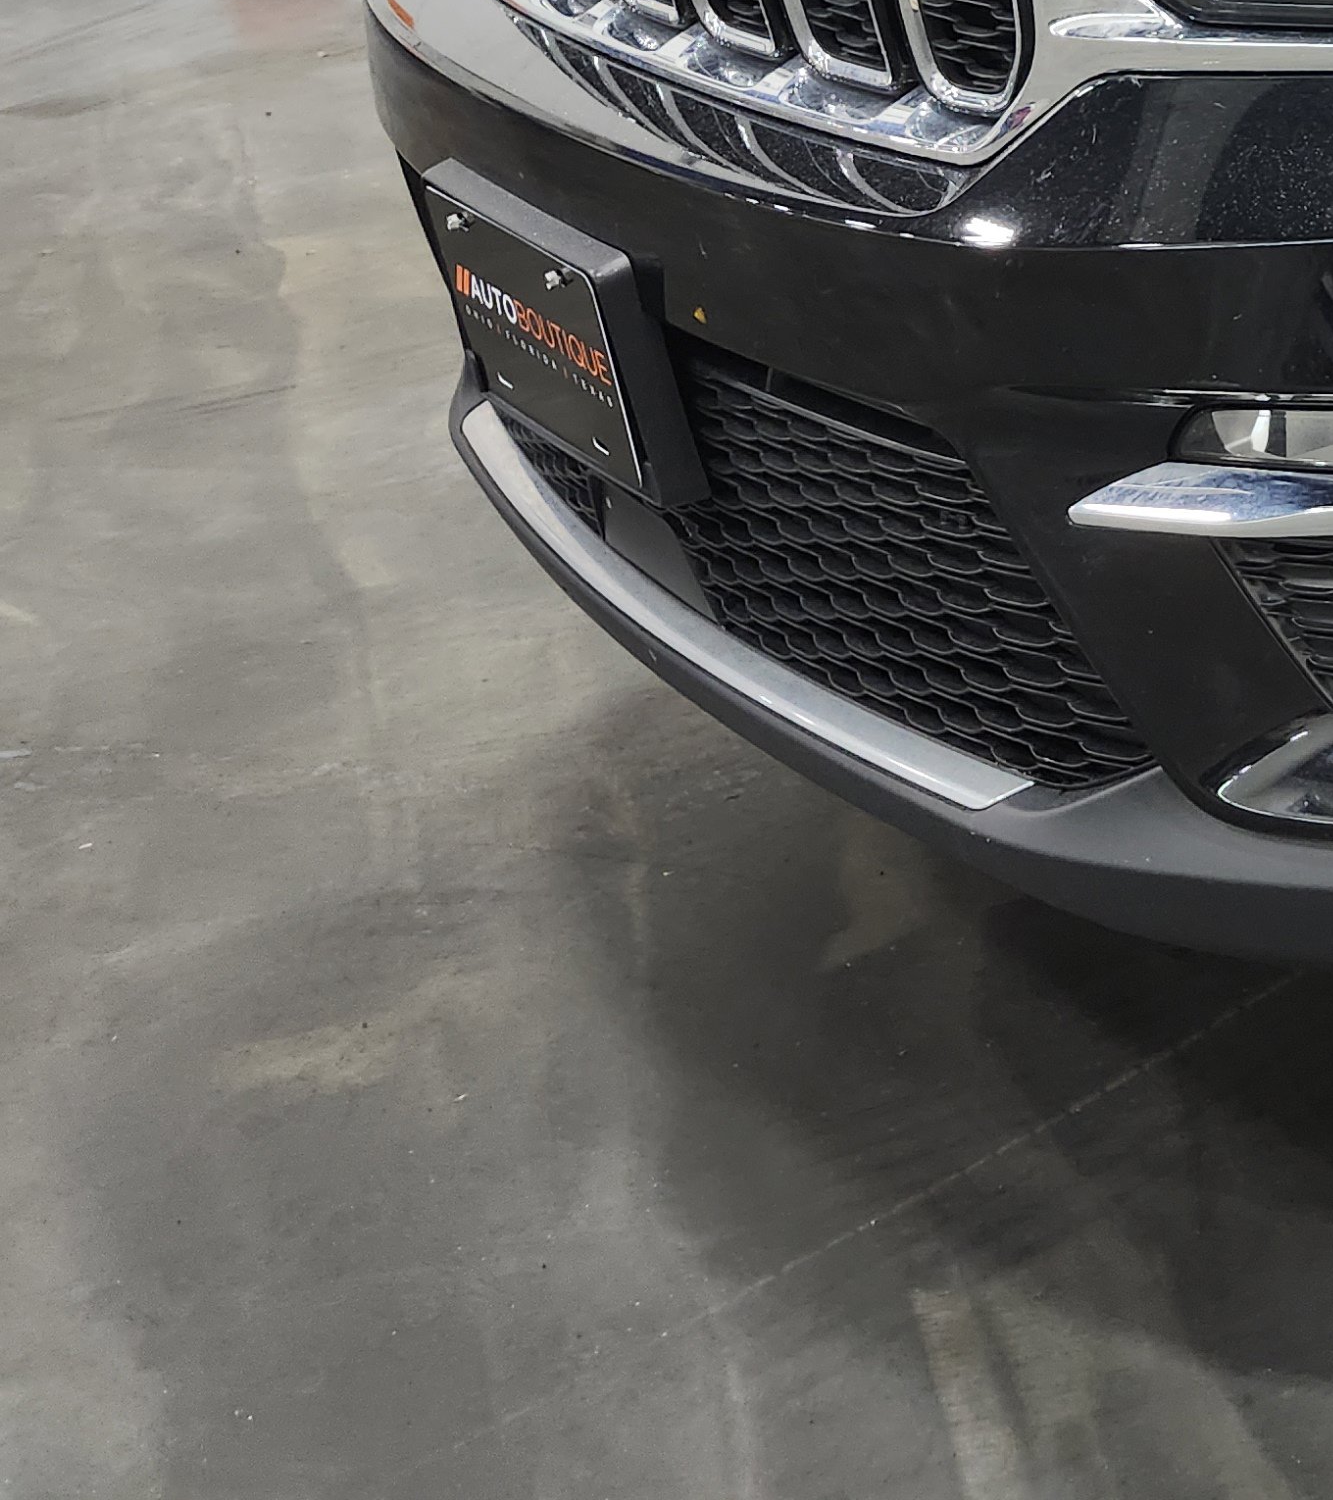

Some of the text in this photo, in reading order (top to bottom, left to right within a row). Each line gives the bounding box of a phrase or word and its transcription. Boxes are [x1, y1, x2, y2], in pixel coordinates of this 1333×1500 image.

[471, 273, 612, 386] AUTOBOUTIQUE
[505, 329, 558, 371] FLORIDA
[572, 373, 614, 408] TEXAS
